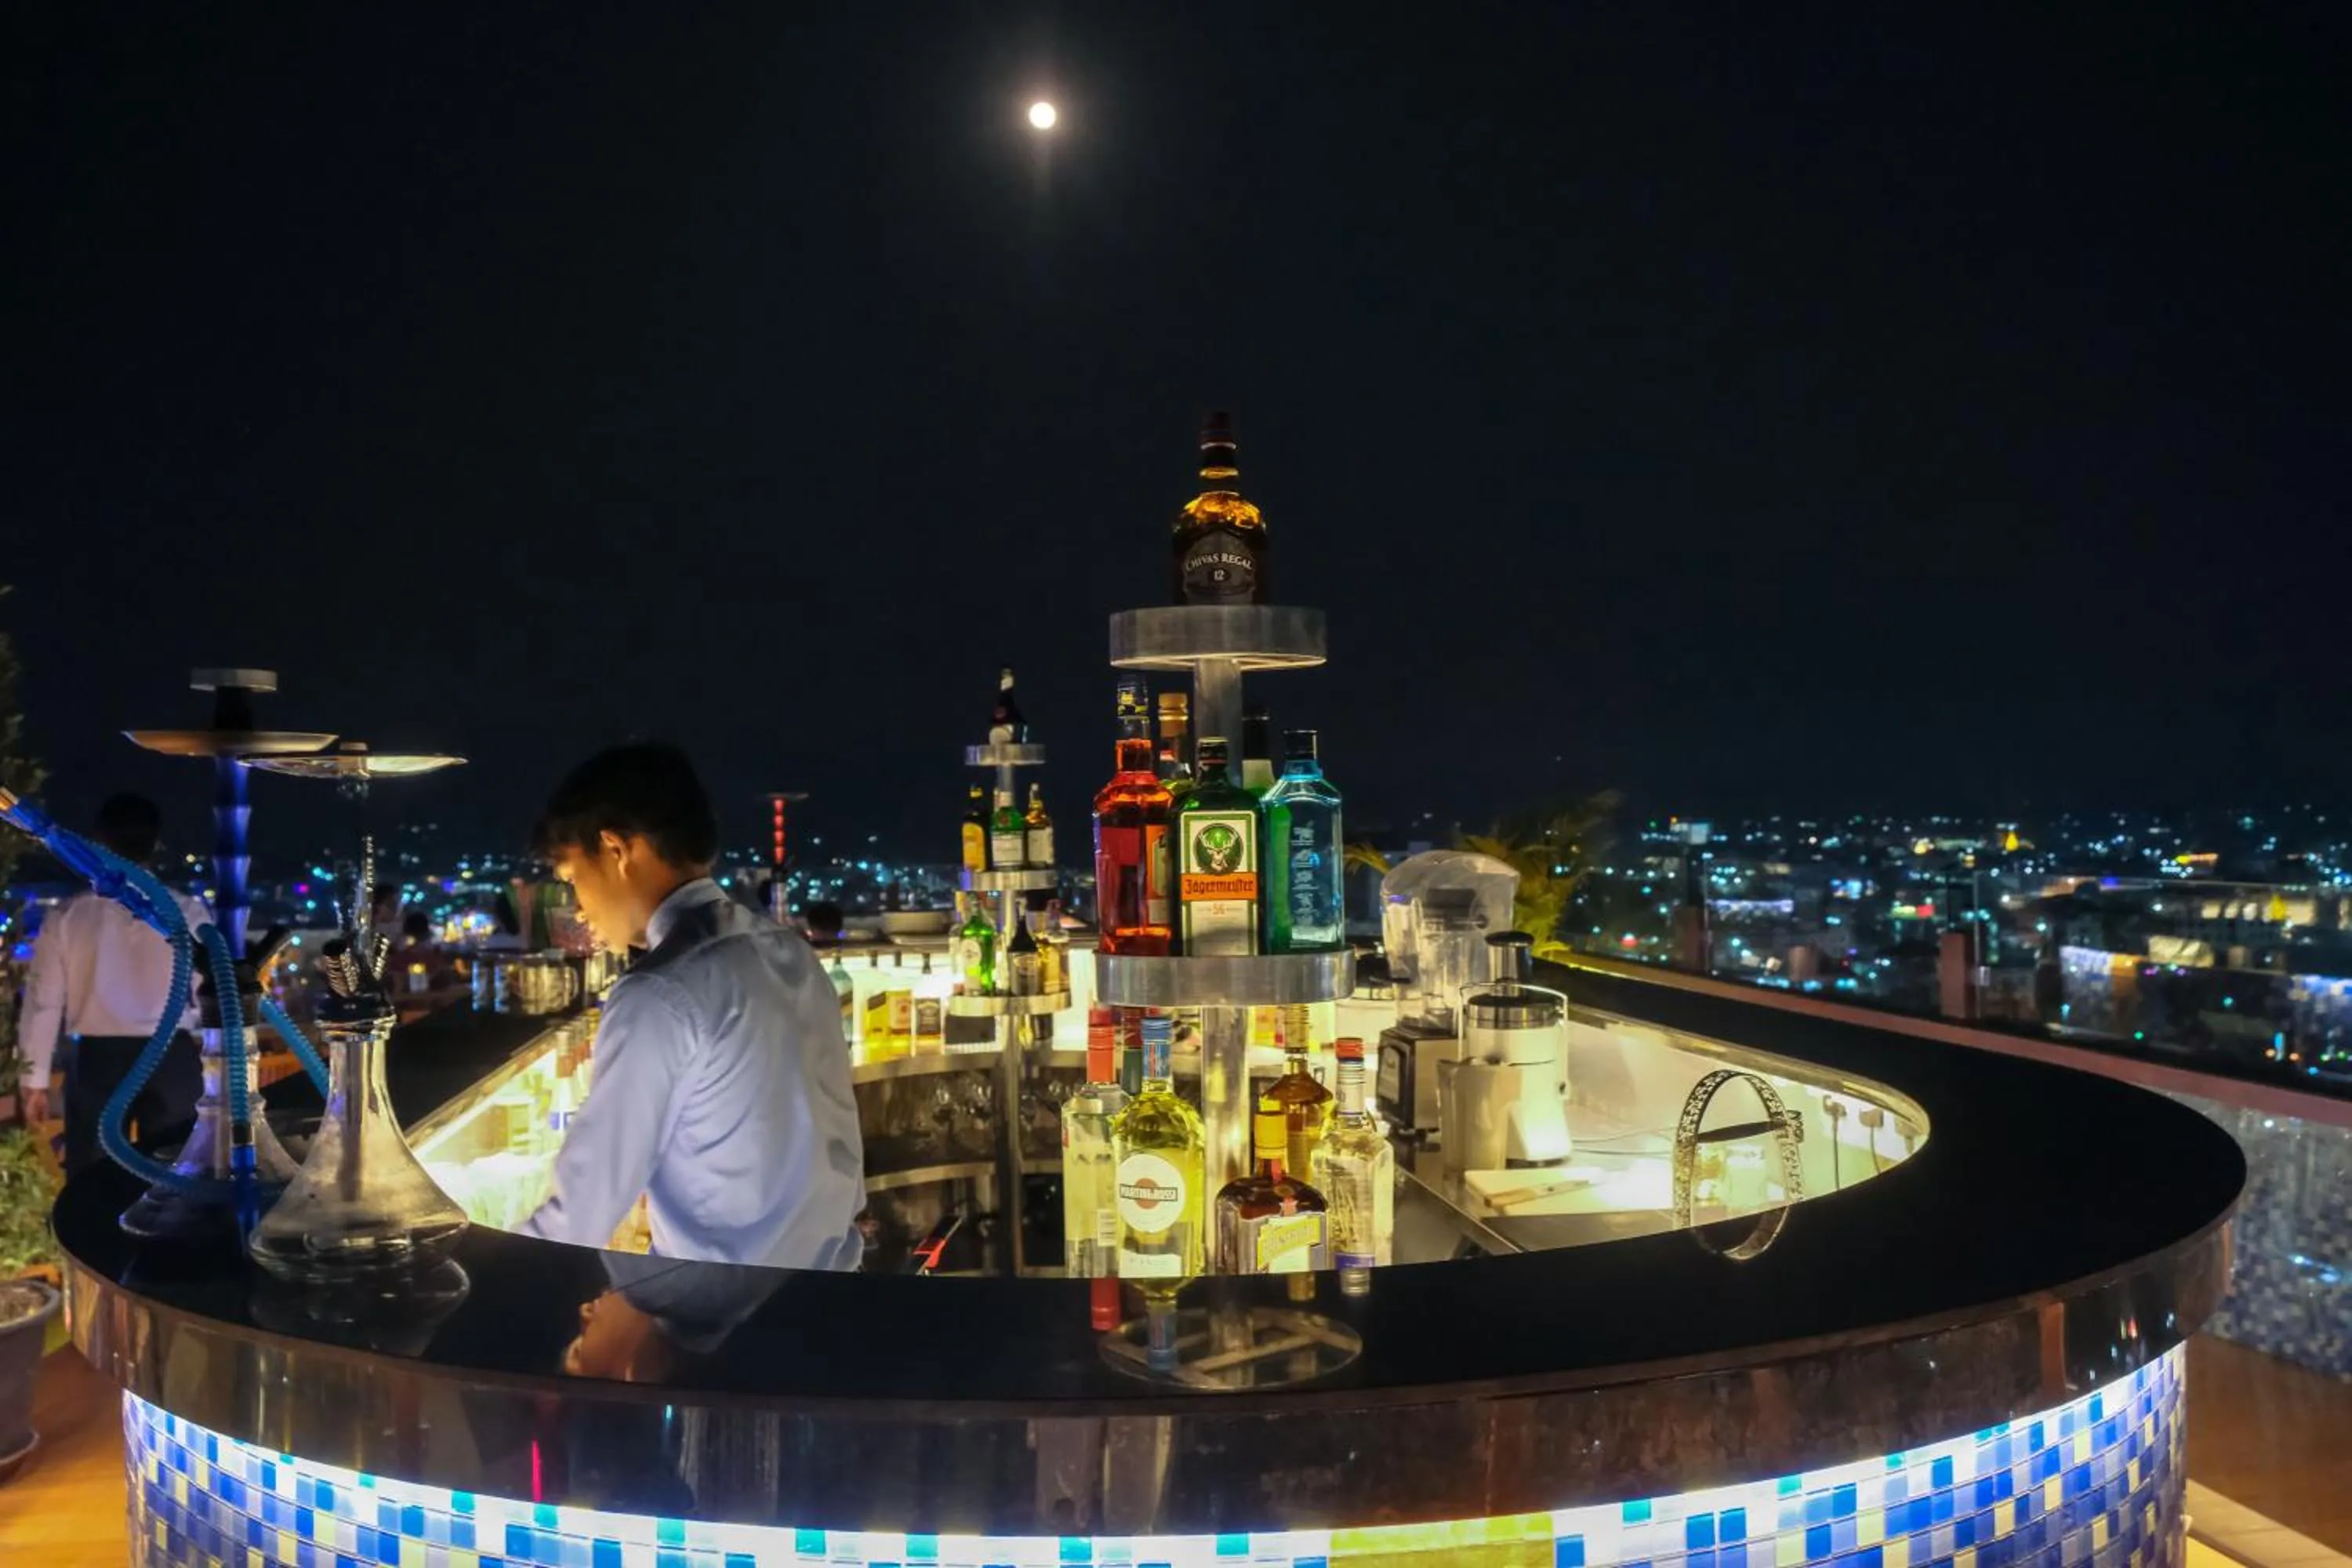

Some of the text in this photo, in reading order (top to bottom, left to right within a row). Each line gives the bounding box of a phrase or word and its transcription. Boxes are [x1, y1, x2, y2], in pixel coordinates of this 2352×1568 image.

[1185, 553, 1252, 572] CHIVAS REGAL
[1214, 569, 1225, 581] 12
